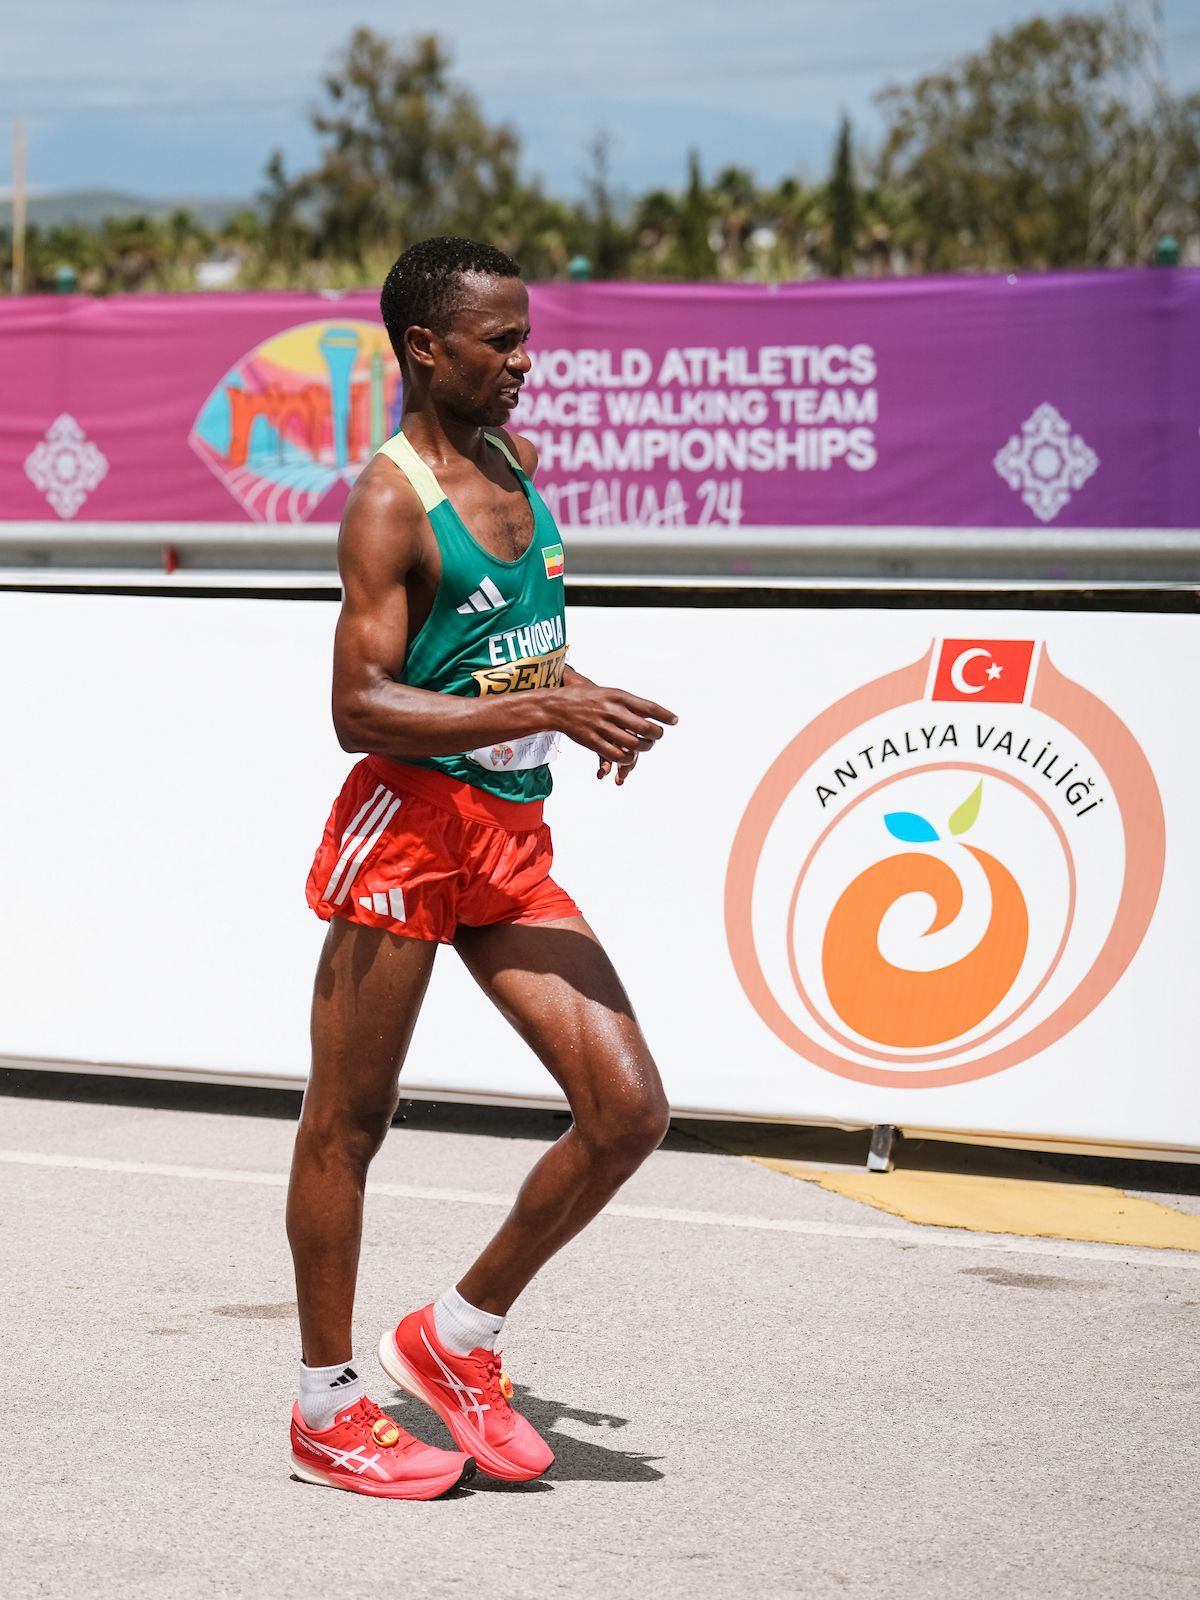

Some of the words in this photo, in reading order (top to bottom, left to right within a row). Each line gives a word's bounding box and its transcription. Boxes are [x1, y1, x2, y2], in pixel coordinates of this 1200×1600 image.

[657, 343, 879, 387] ATHLETICS
[508, 390, 601, 427] RACE
[604, 388, 769, 427] WALKING
[771, 387, 879, 425] TEAM
[696, 477, 744, 527] 24
[488, 614, 564, 667] ETHIOPIA
[814, 723, 960, 808] ANTALYA
[975, 723, 1105, 818] VALİLİĞİ
